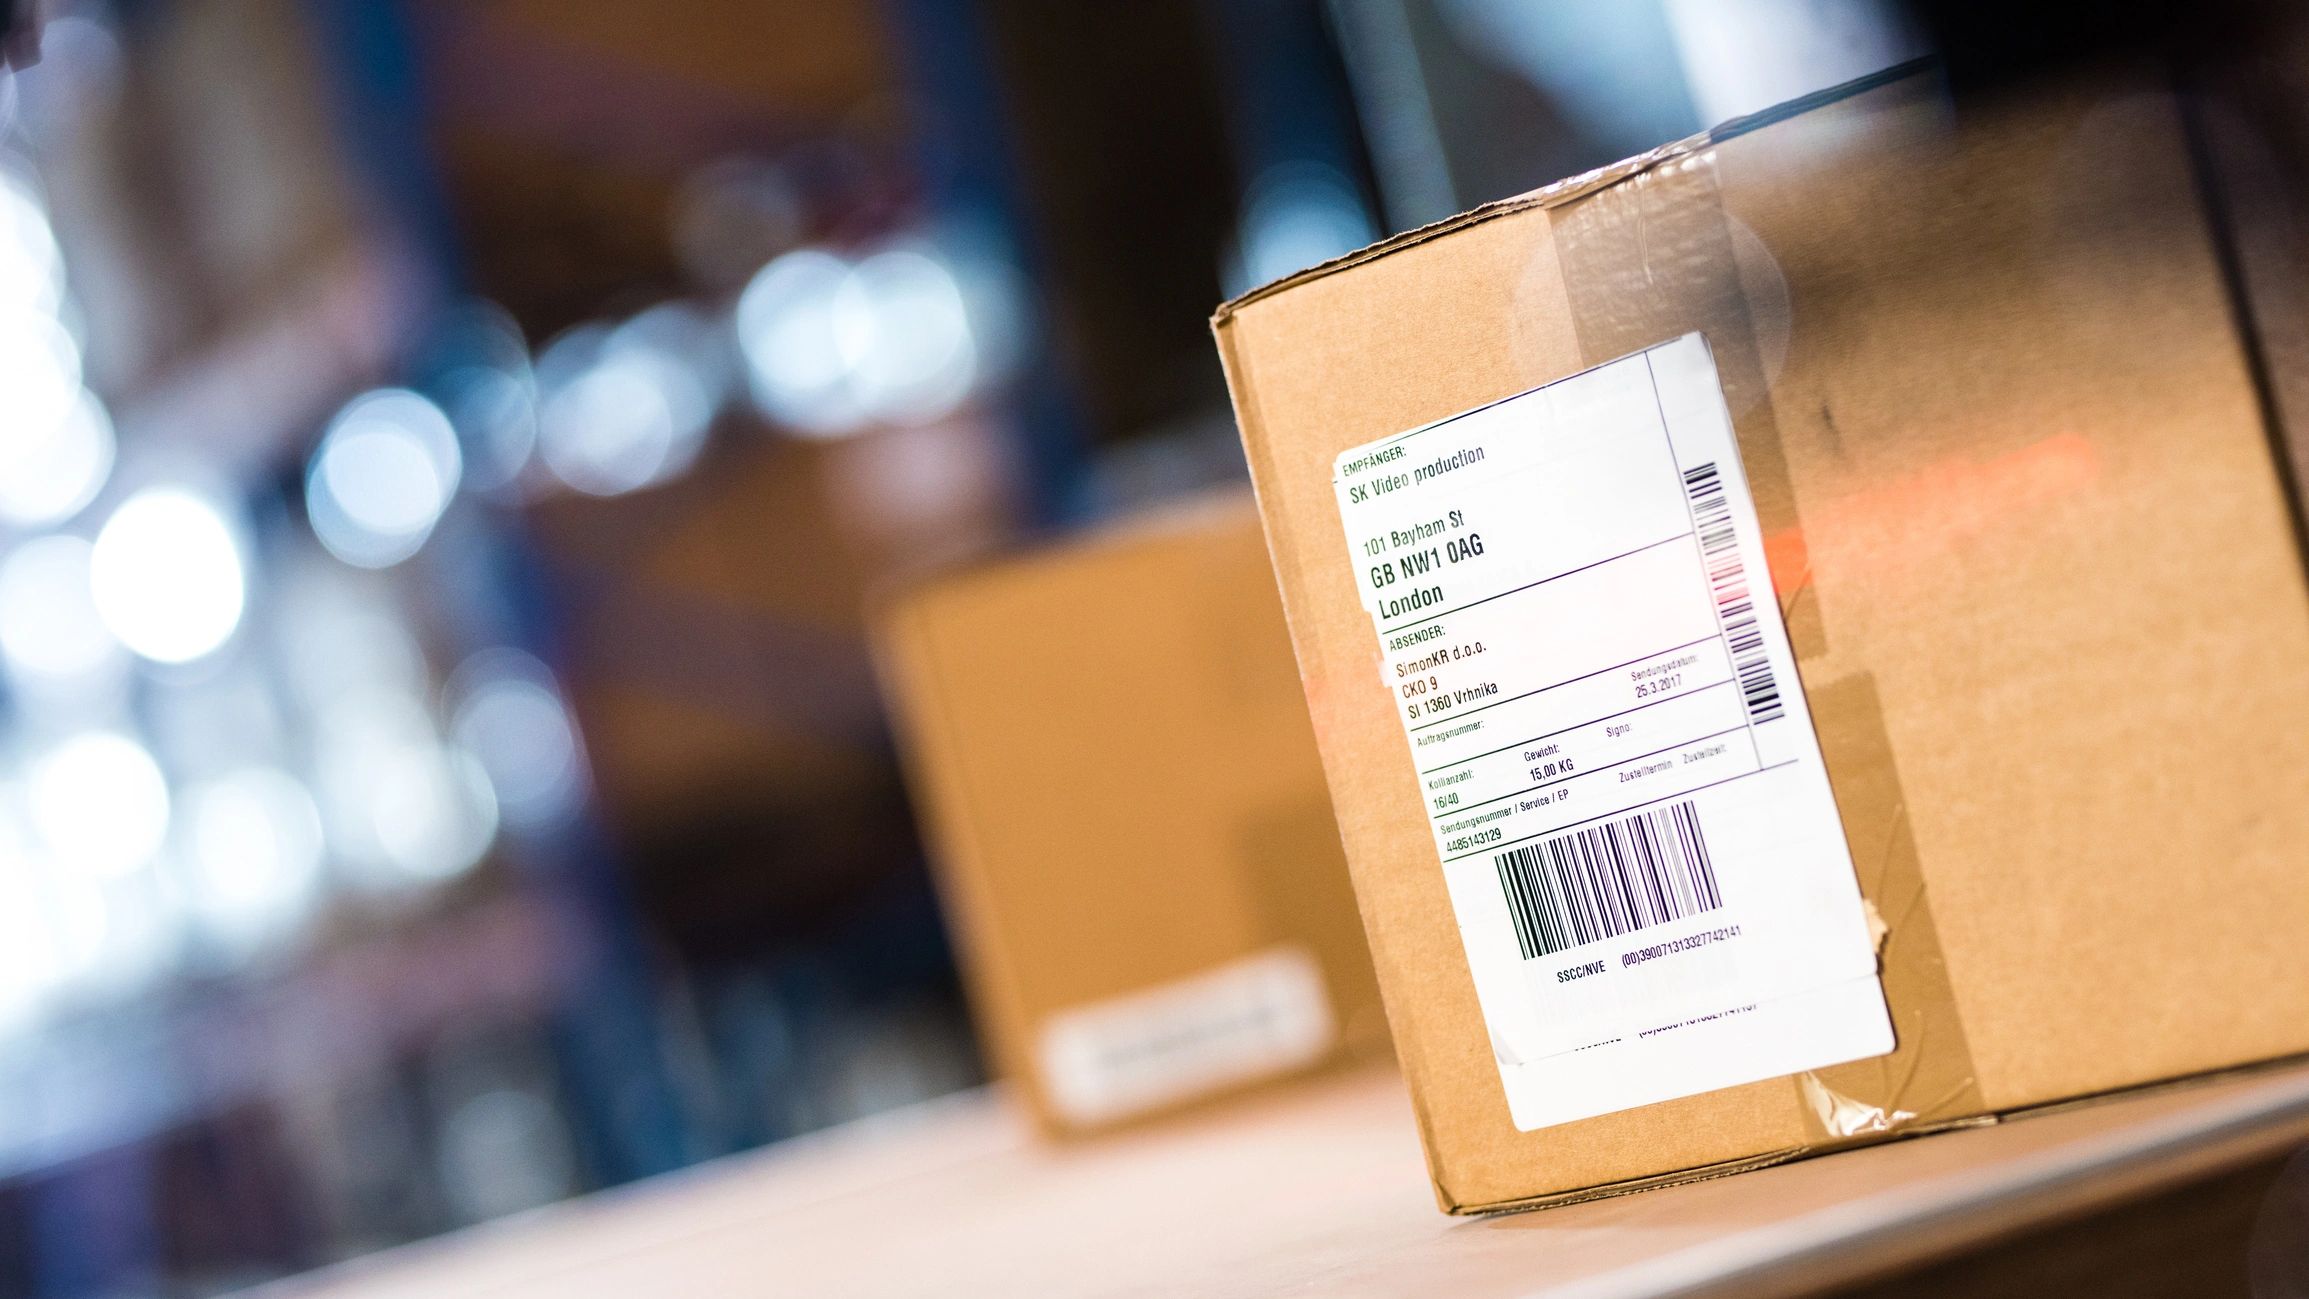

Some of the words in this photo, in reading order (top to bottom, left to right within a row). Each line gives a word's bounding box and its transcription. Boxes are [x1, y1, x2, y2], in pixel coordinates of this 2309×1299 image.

[1350, 484, 1370, 504] SK
[1372, 472, 1410, 497] Video
[1414, 445, 1485, 485] production
[1363, 536, 1387, 557] 101
[1391, 520, 1445, 549] Bayham
[1448, 509, 1464, 528] St
[1370, 562, 1396, 588] GB
[1400, 548, 1441, 579] NW1
[1446, 534, 1484, 564] 0AG
[1379, 585, 1444, 620] London
[1389, 625, 1446, 652] ABSENDER:
[1396, 650, 1450, 678] SimonKR
[1452, 641, 1487, 660] d.o.o.
[1402, 682, 1426, 699] CKO
[1430, 676, 1438, 690] 9
[1636, 674, 1682, 698] 25.3.2017
[1408, 705, 1422, 720] SI
[1424, 696, 1452, 714] 1360
[1454, 682, 1498, 705] Vrhnika
[1417, 720, 1484, 748] Auftragsnummer:
[1606, 722, 1632, 738] Signo:
[1524, 744, 1560, 762] Gewicht:
[1428, 769, 1474, 790] Kollianzahl:
[1530, 763, 1557, 782] 15,00
[1558, 758, 1574, 773] KG
[1619, 759, 1673, 782] Zustelltermin
[1434, 792, 1460, 810] 16/40
[1440, 806, 1512, 834] Sendungsnummer
[1520, 796, 1550, 812] Service
[1558, 788, 1570, 800] EP
[1446, 828, 1502, 854] 4485143129
[1557, 960, 1606, 984] SSCC/NVE
[1622, 925, 1742, 968] (00)390071313327742141
